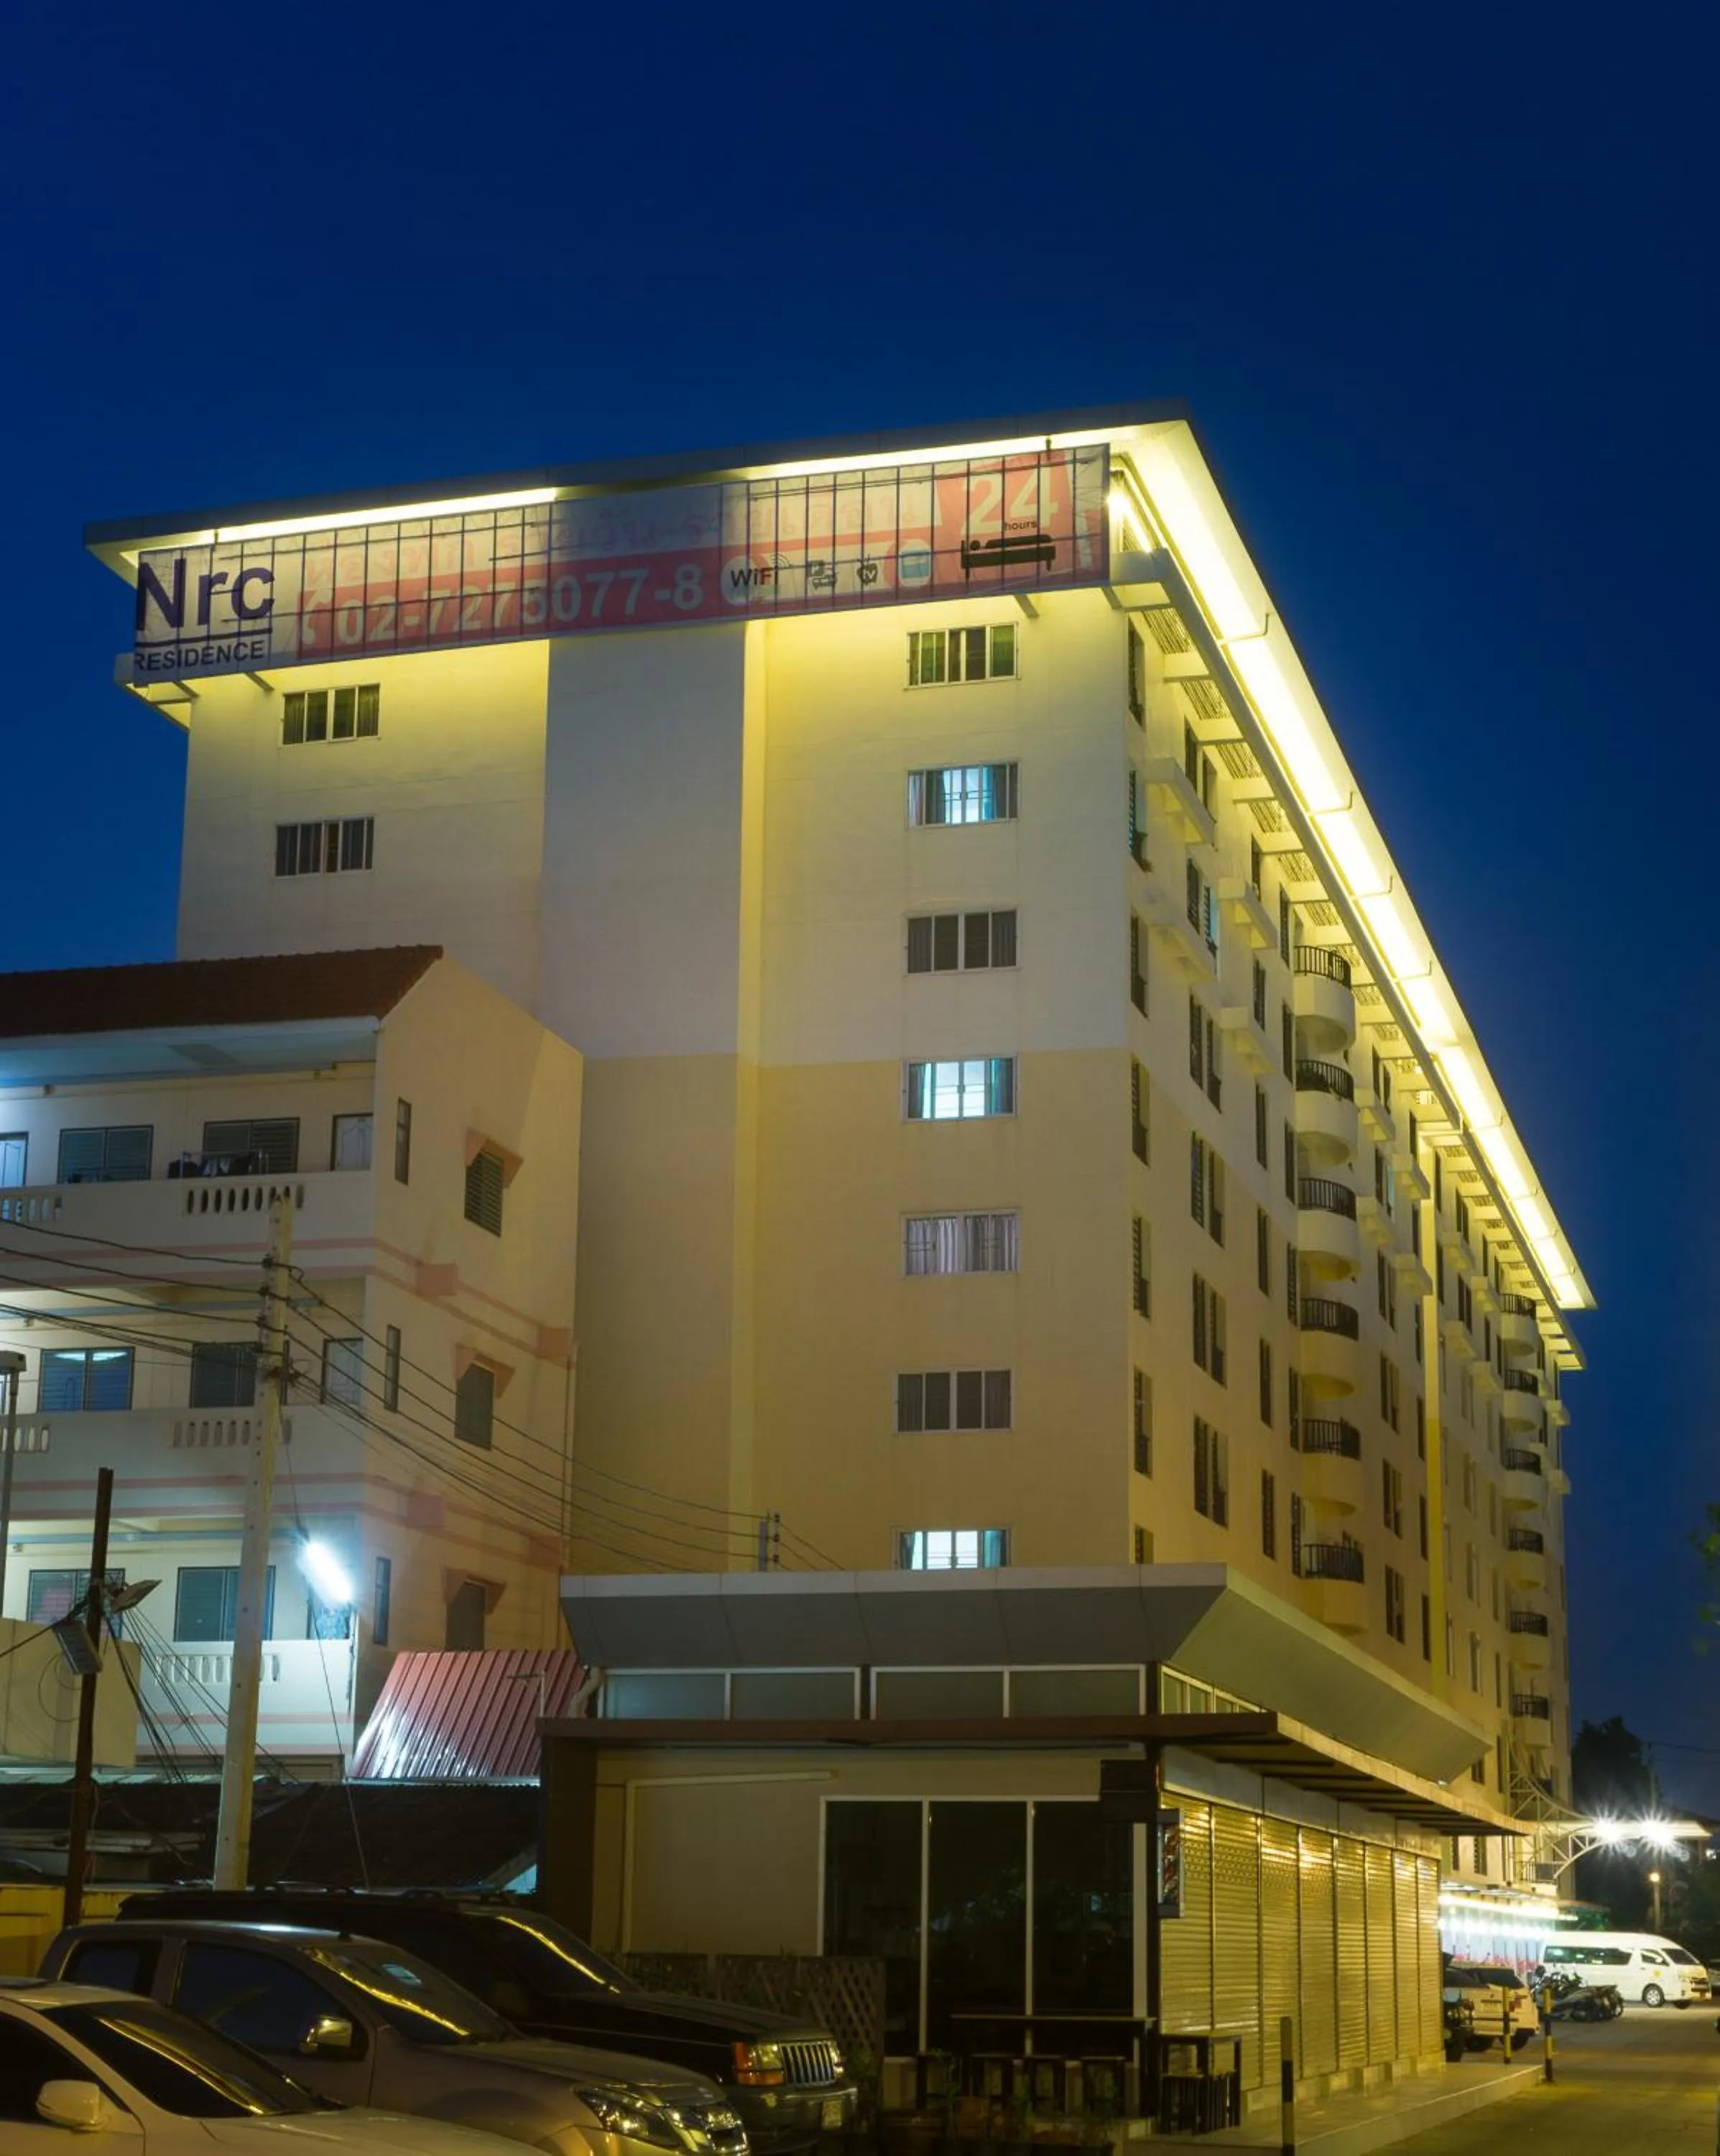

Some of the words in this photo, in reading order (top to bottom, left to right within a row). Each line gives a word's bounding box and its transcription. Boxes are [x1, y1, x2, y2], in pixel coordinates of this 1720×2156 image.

[961, 466, 1059, 536] 24
[1002, 520, 1037, 530] hours
[137, 558, 275, 631] Nrc
[338, 563, 703, 645] 02-7275077-8
[134, 640, 264, 671] RESIDENCE
